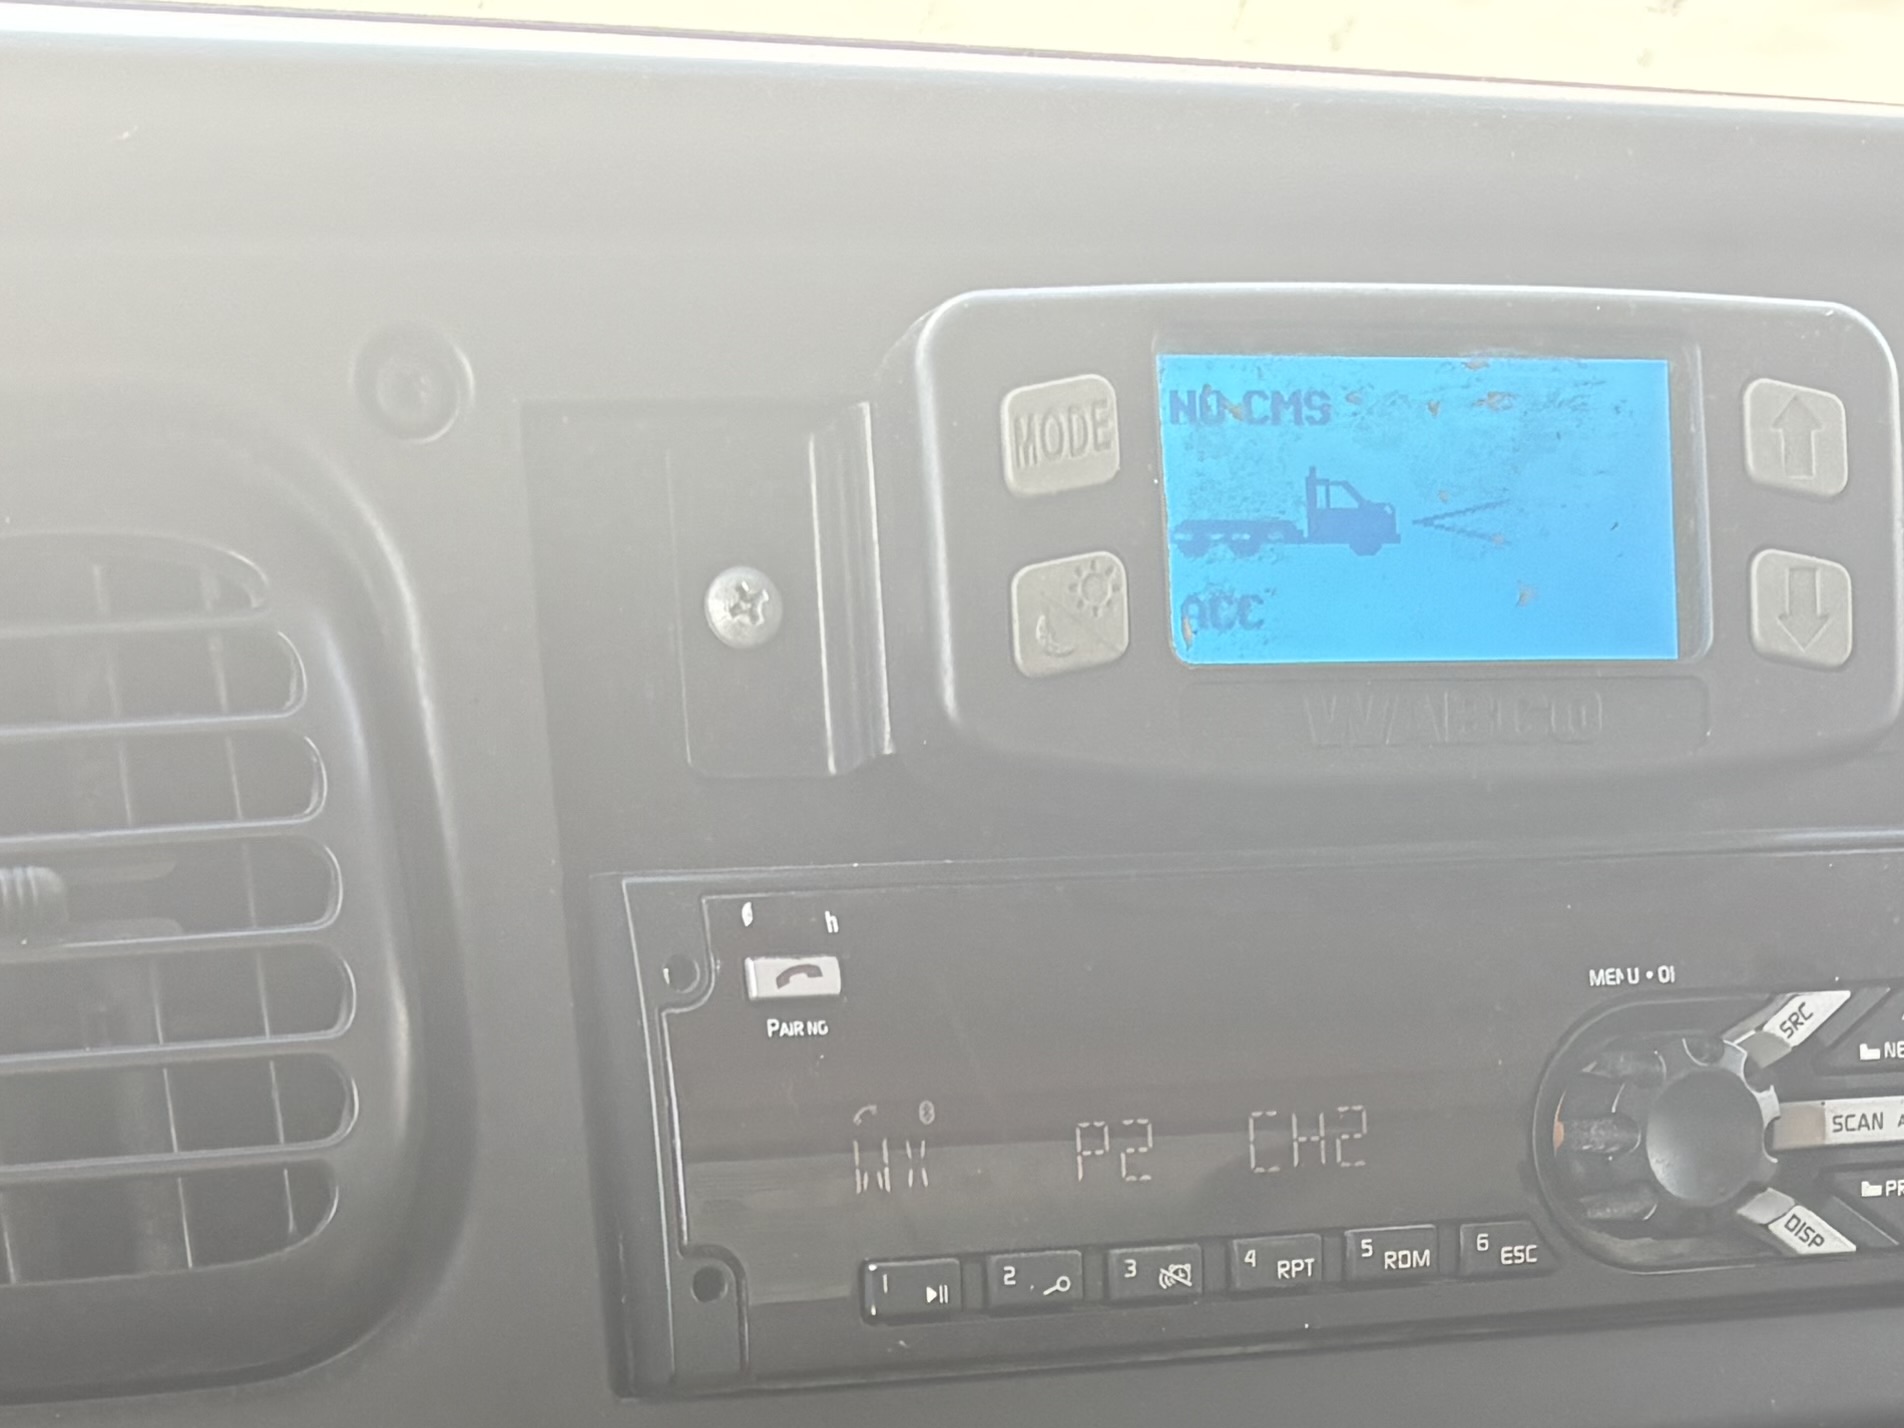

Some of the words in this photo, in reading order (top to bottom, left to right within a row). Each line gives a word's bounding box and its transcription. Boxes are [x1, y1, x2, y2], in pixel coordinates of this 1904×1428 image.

[1169, 389, 1228, 426] NO
[1242, 389, 1331, 426] CMS
[1014, 398, 1114, 469] MODE
[1181, 594, 1264, 632] ACC
[1779, 1001, 1814, 1039] SRC
[1832, 1112, 1884, 1133] SCAN
[1075, 1118, 1153, 1183] P2
[1248, 1105, 1367, 1174] CH2
[1784, 1213, 1825, 1249] DISP
[1243, 1249, 1257, 1268] 4
[1277, 1257, 1316, 1280] RPT
[1360, 1239, 1373, 1258] 5
[1383, 1248, 1431, 1270] RDM
[1475, 1233, 1489, 1252] 6
[1501, 1244, 1538, 1265] ESC
[1003, 1266, 1017, 1286] 2
[1123, 1259, 1137, 1278] 3
